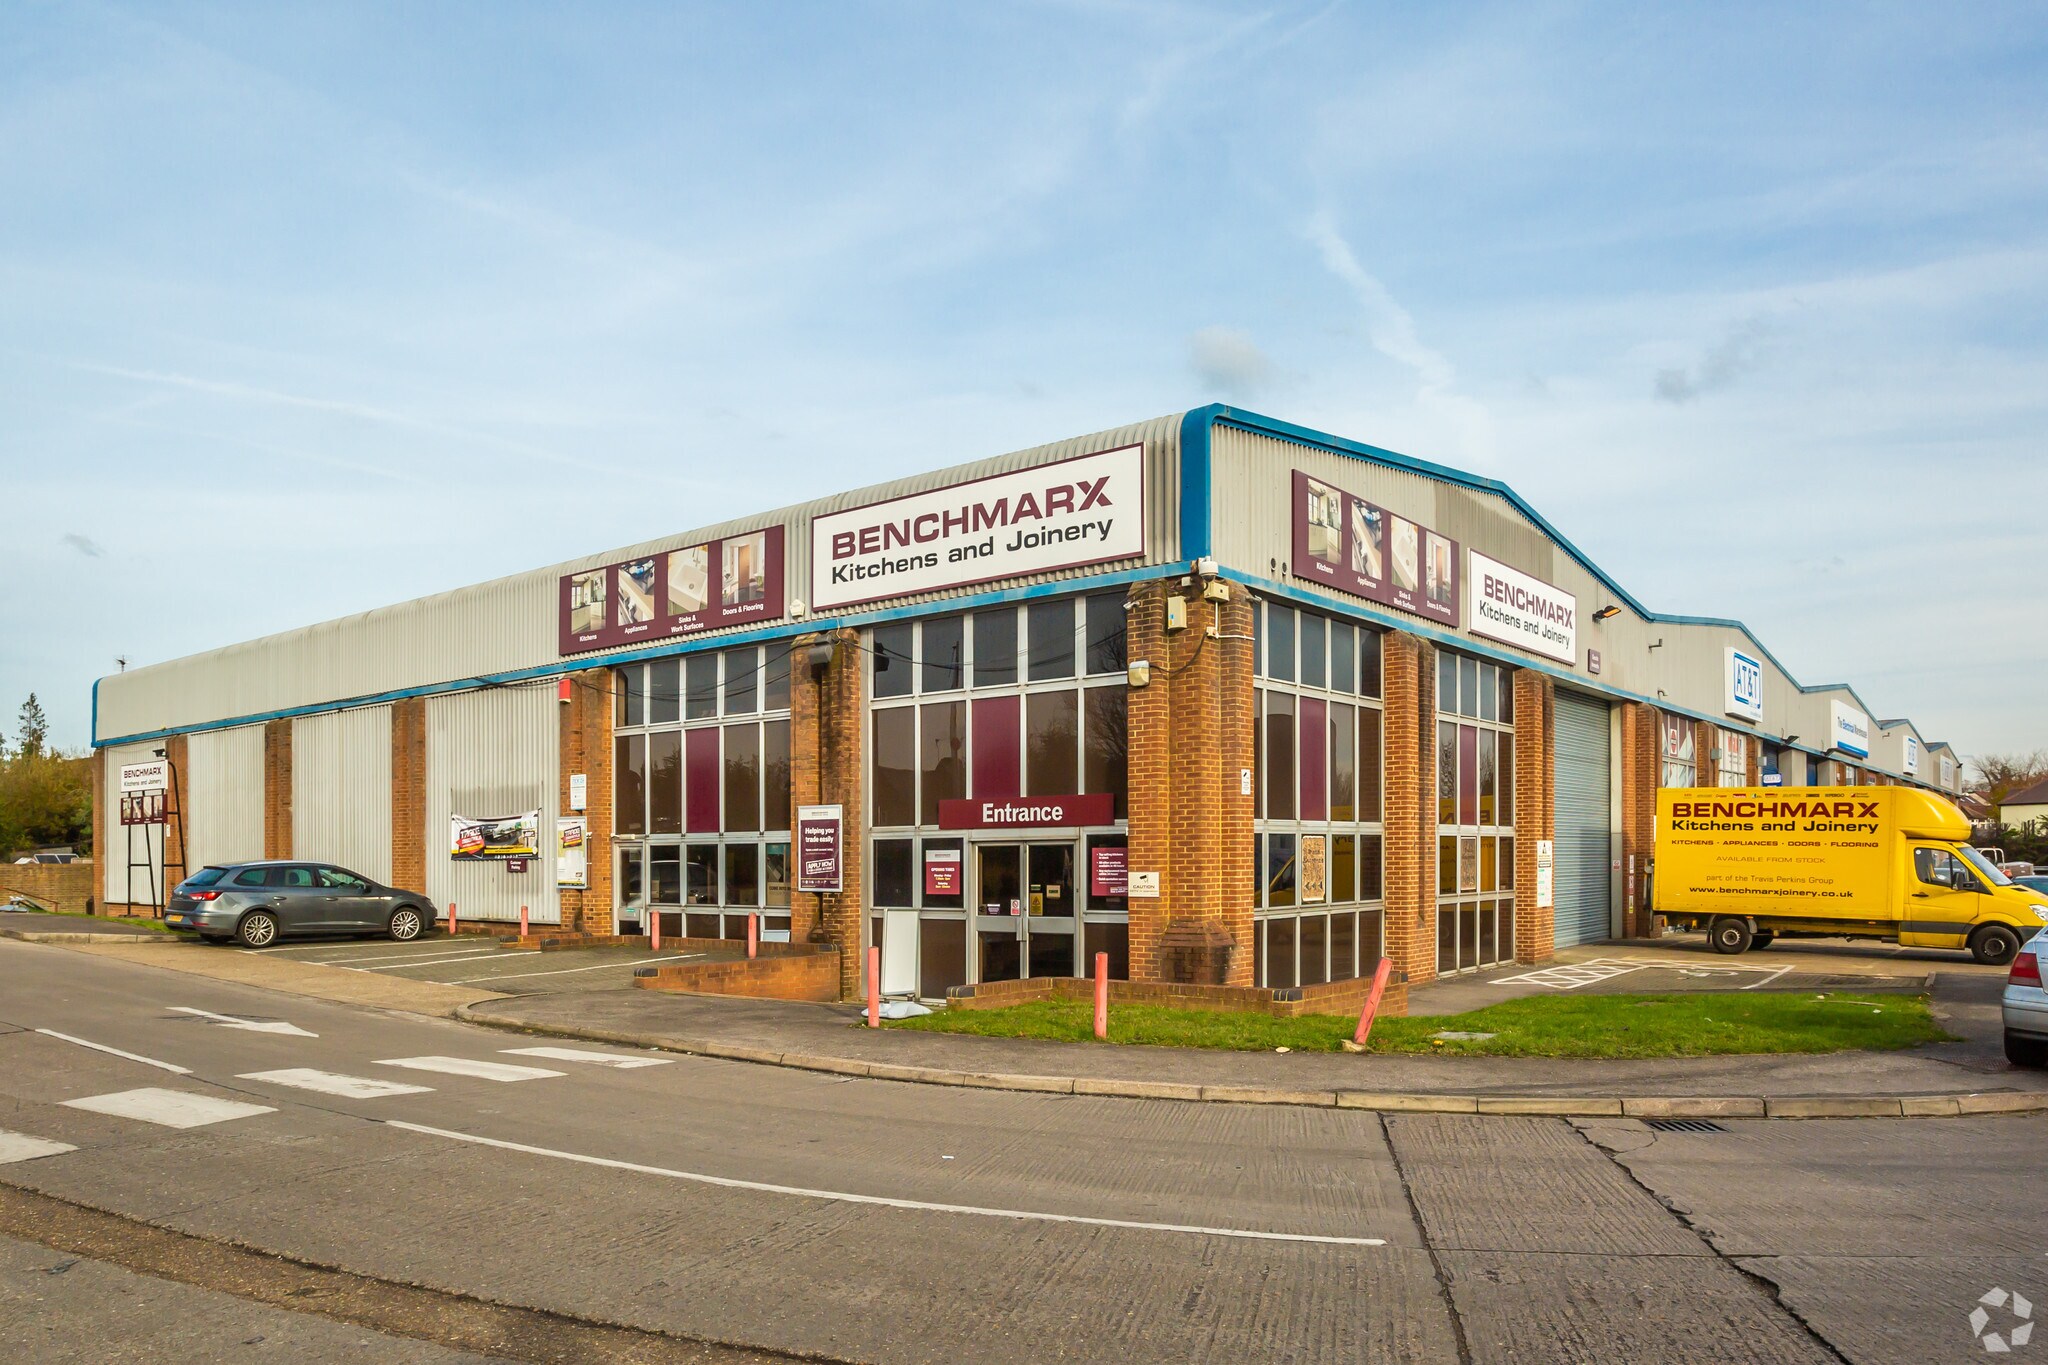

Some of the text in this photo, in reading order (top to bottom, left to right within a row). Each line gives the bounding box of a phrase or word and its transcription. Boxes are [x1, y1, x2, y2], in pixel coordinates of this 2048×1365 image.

[832, 476, 1113, 560] BENCHMARX
[832, 519, 1113, 584] Kitchens and Joinery
[1484, 574, 1573, 629] BENCHMARX
[722, 606, 737, 616] Doors
[743, 602, 764, 613] Flooring
[678, 615, 691, 624] Sinks
[1480, 600, 1570, 650] Kitchens and Joinery
[624, 624, 648, 635] Appliances
[670, 621, 704, 633] Work Surfaces
[579, 633, 598, 643] Kitchens
[1736, 664, 1758, 699] AT&T
[124, 767, 161, 778] BENCHMARX
[982, 802, 1063, 823] Entrance
[1672, 802, 1879, 818] BENCHMARX
[805, 827, 825, 836] Helping
[1672, 820, 1879, 834] Kitchens and Joinery
[819, 835, 834, 844] easily
[1706, 875, 1722, 883] part
[1725, 874, 1733, 882] of
[1751, 875, 1774, 883] Travis
[1808, 877, 1834, 885] Group
[1689, 886, 1853, 898] www.benchmarxjoinery.co.uk
